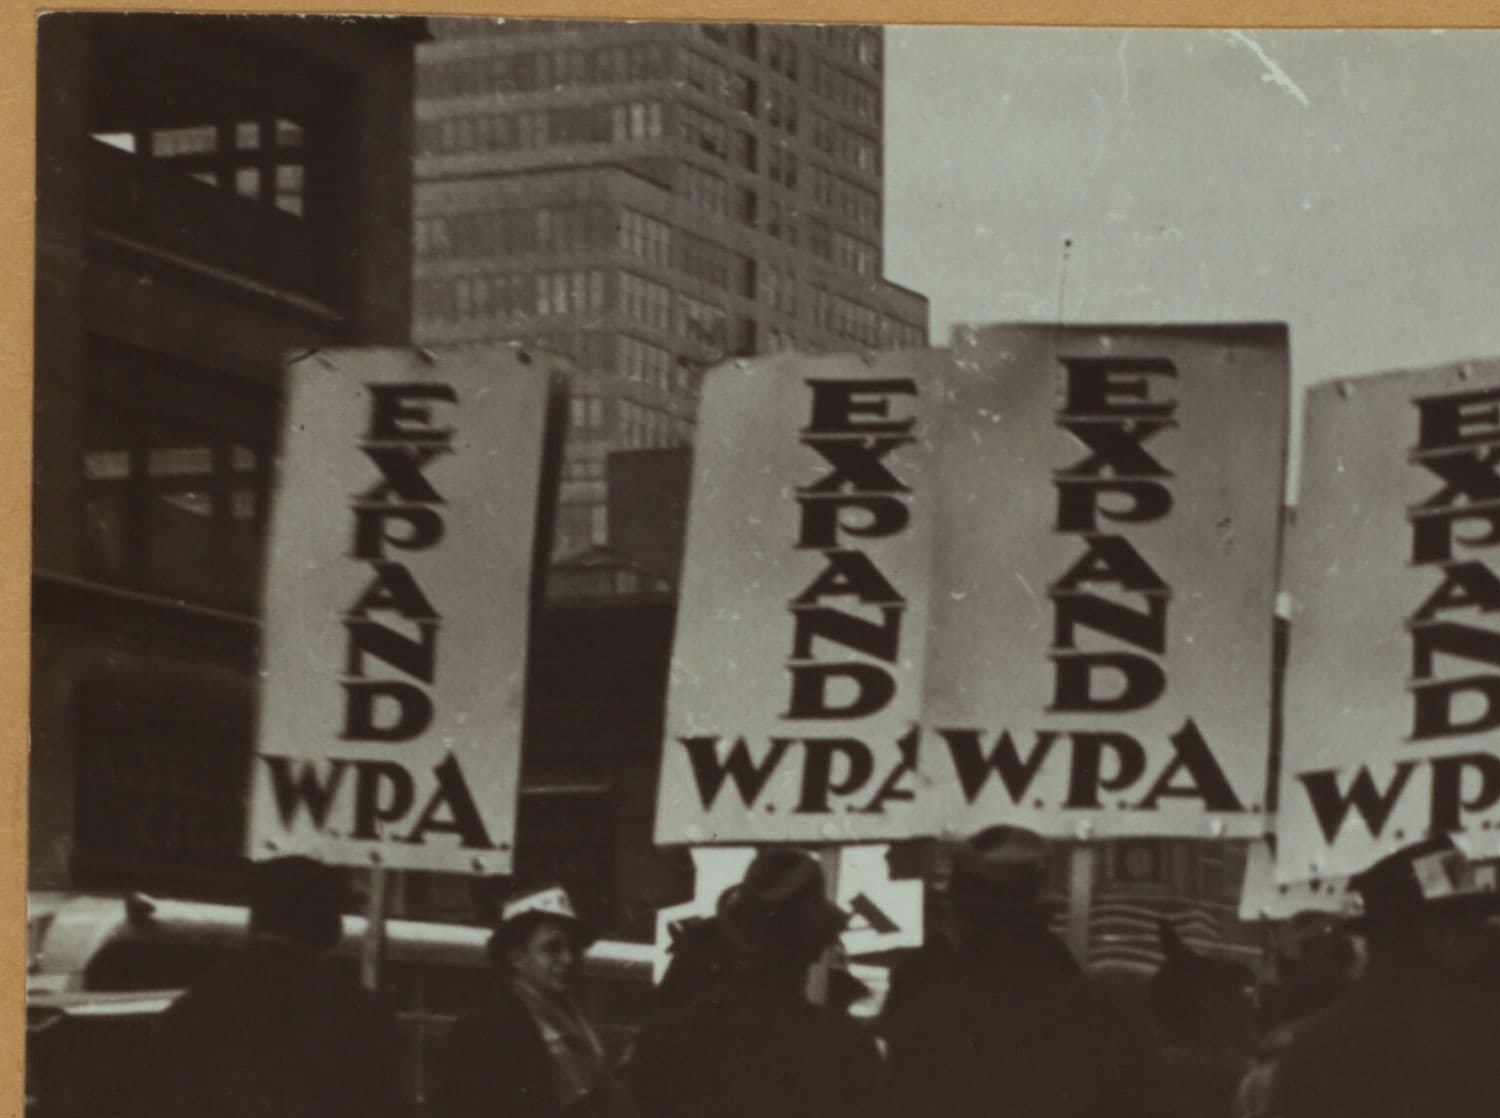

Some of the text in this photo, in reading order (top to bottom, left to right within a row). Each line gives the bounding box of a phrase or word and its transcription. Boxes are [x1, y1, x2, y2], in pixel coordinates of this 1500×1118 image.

[335, 383, 458, 743] EXPAND
[780, 377, 919, 720] EXPAND
[1044, 356, 1180, 713] EXPAND
